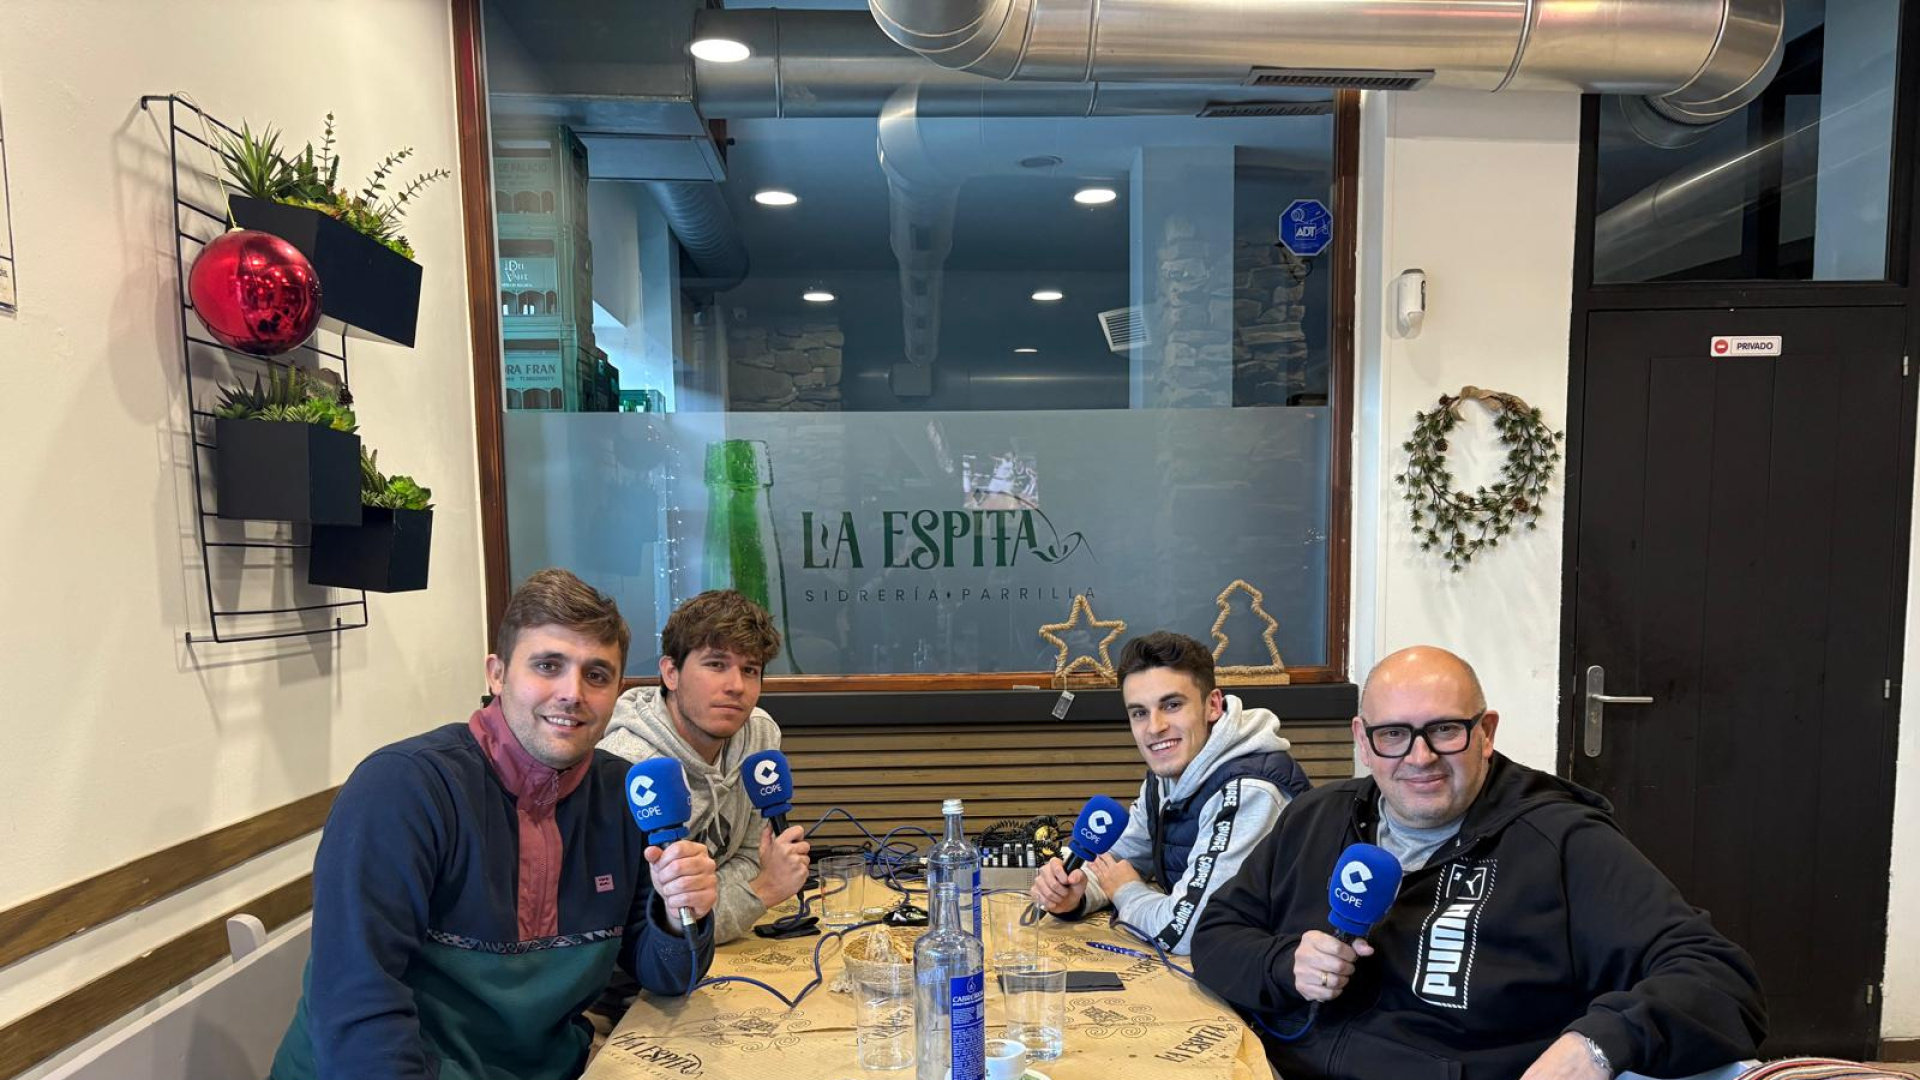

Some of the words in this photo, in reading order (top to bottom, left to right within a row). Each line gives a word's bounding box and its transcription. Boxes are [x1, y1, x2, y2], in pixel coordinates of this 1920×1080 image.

[1296, 226, 1316, 237] ADT
[1737, 342, 1774, 350] PRIVADO
[505, 364, 522, 374] RA
[526, 364, 556, 374] FRAN
[802, 511, 864, 569] LA
[883, 509, 1038, 570] ESPITA
[805, 586, 938, 602] SIDRERÍA
[962, 587, 1095, 600] PARRILLA
[760, 784, 782, 796] COPE
[636, 805, 663, 820] COPE
[1081, 828, 1100, 844] COPE
[1334, 887, 1363, 908] COPE
[1422, 903, 1476, 997] PUMA
